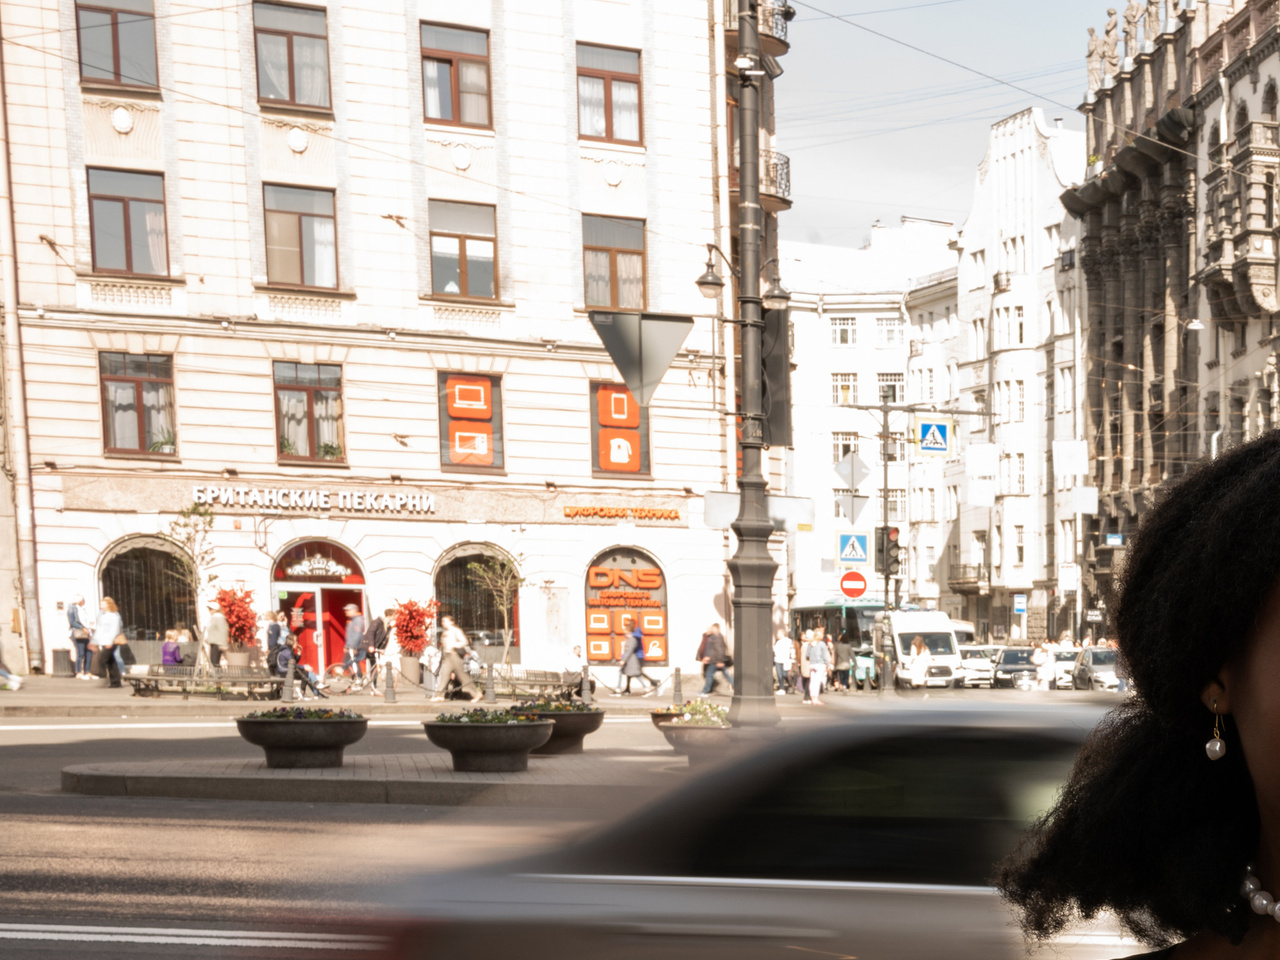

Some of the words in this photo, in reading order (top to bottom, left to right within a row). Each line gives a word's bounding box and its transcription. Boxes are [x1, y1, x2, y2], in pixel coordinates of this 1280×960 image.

[192, 486, 331, 508] БРИТАНСКИЕ
[338, 491, 436, 513] ПЕКАРНИ
[631, 508, 680, 520] ТЕХНИКА
[588, 566, 662, 588] DNS
